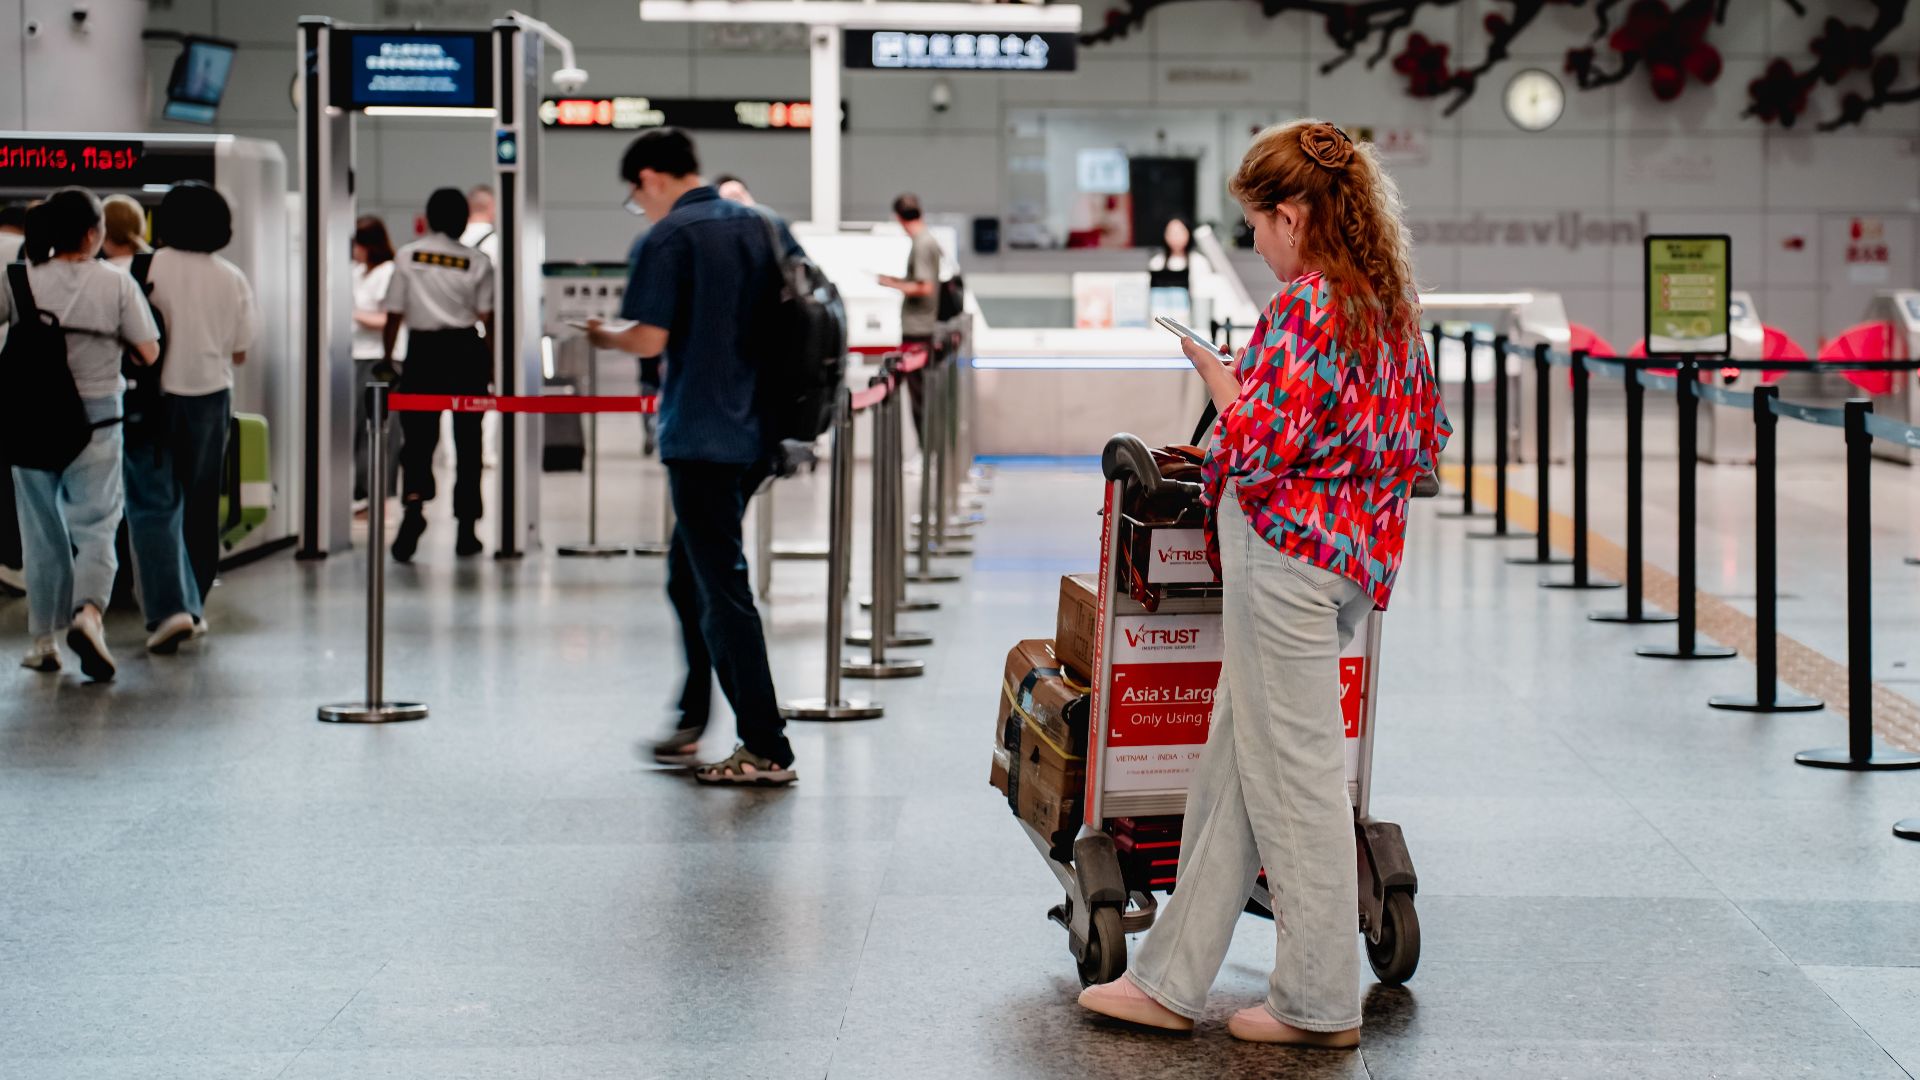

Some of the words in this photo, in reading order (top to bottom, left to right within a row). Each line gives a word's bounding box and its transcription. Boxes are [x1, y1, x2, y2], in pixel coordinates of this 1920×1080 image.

[1099, 561, 1108, 611] Helping
[1094, 656, 1102, 690] Sleep
[1121, 686, 1171, 702] Asia's
[1131, 712, 1162, 728] Only
[1166, 712, 1203, 727] Using
[1115, 753, 1148, 763] VIETNAM
[1157, 752, 1179, 761] INDIA
